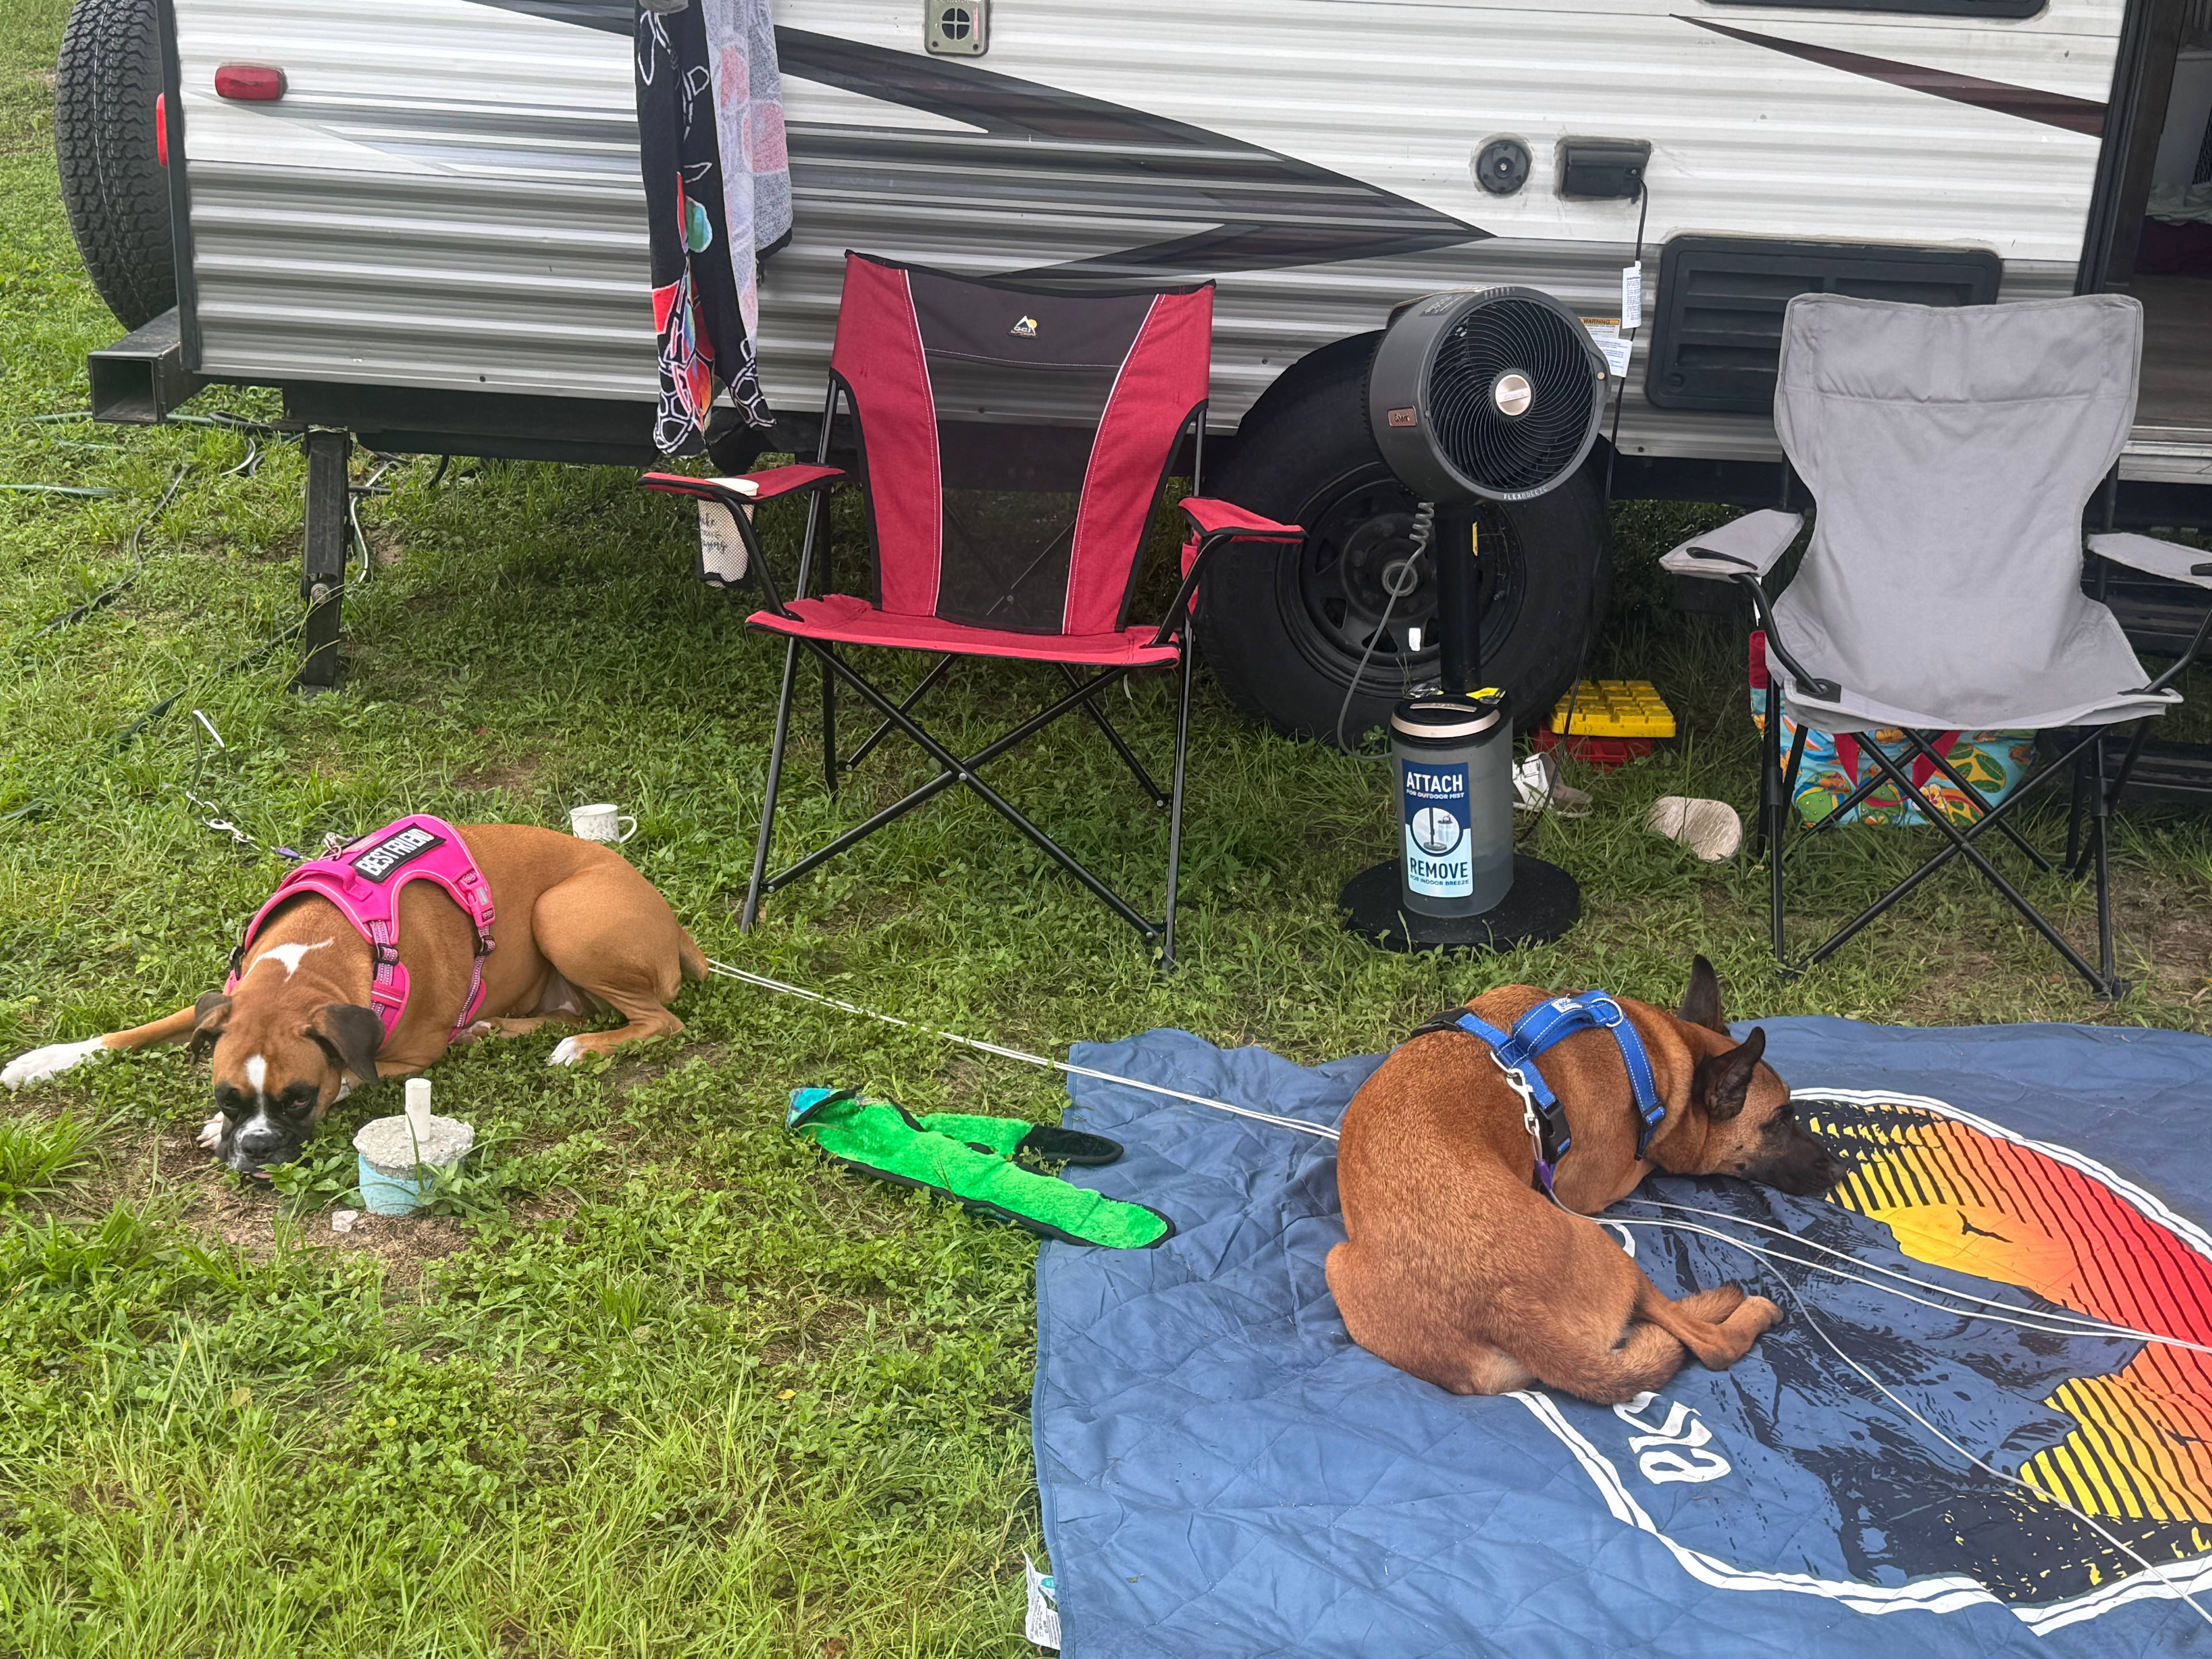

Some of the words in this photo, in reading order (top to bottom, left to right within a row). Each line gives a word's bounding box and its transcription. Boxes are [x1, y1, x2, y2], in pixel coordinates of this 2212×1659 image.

[1503, 486, 1547, 500] FLEXBREEZE
[1406, 771, 1463, 793] ATTACH
[355, 847, 399, 876] BEST
[382, 828, 434, 856] FRIEND
[1410, 857, 1468, 879] REMOVE
